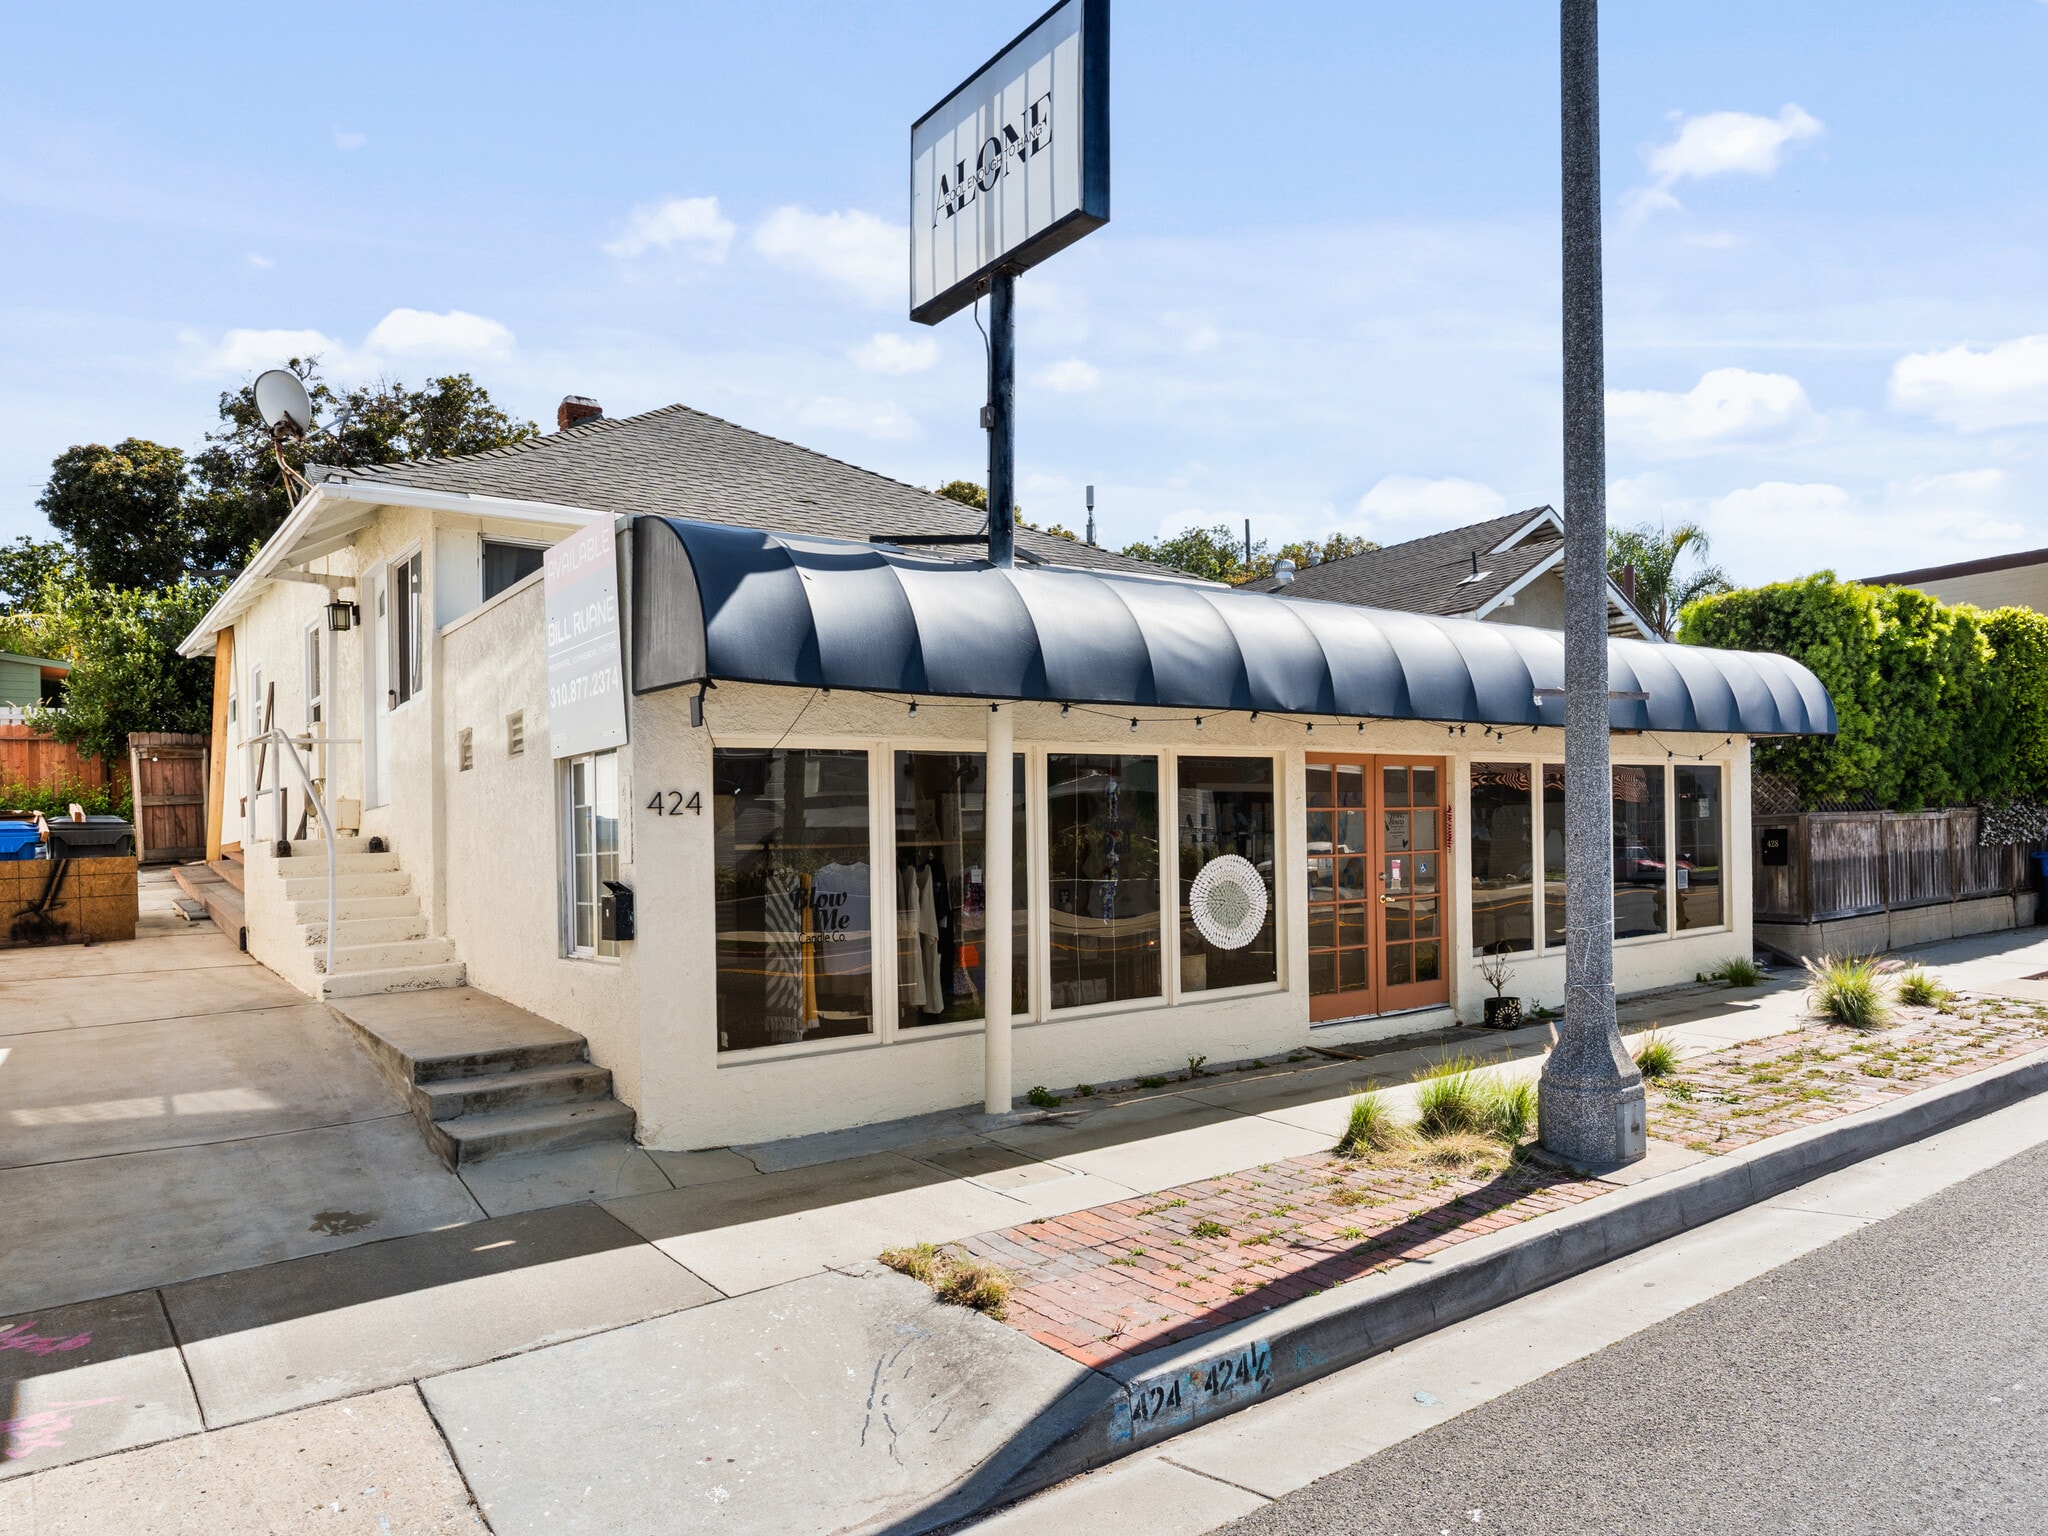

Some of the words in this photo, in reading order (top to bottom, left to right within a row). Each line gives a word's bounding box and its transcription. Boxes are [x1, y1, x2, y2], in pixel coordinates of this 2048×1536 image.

[932, 91, 1053, 229] ALONE
[944, 183, 966, 204] COOL
[967, 155, 1002, 189] ENOUGH
[1003, 143, 1016, 160] TO
[1017, 123, 1043, 152] HANG
[547, 527, 610, 584] AVAILABLE
[548, 616, 572, 648] BILL
[573, 595, 615, 636] RUANE
[550, 666, 619, 709] 310.877.2374
[647, 791, 703, 817] 424
[1767, 840, 1780, 848] 428
[789, 886, 848, 911] Blow
[812, 907, 850, 932] Me
[798, 932, 831, 945] Candle
[831, 930, 847, 942] Co.
[1132, 1380, 1182, 1422] 424
